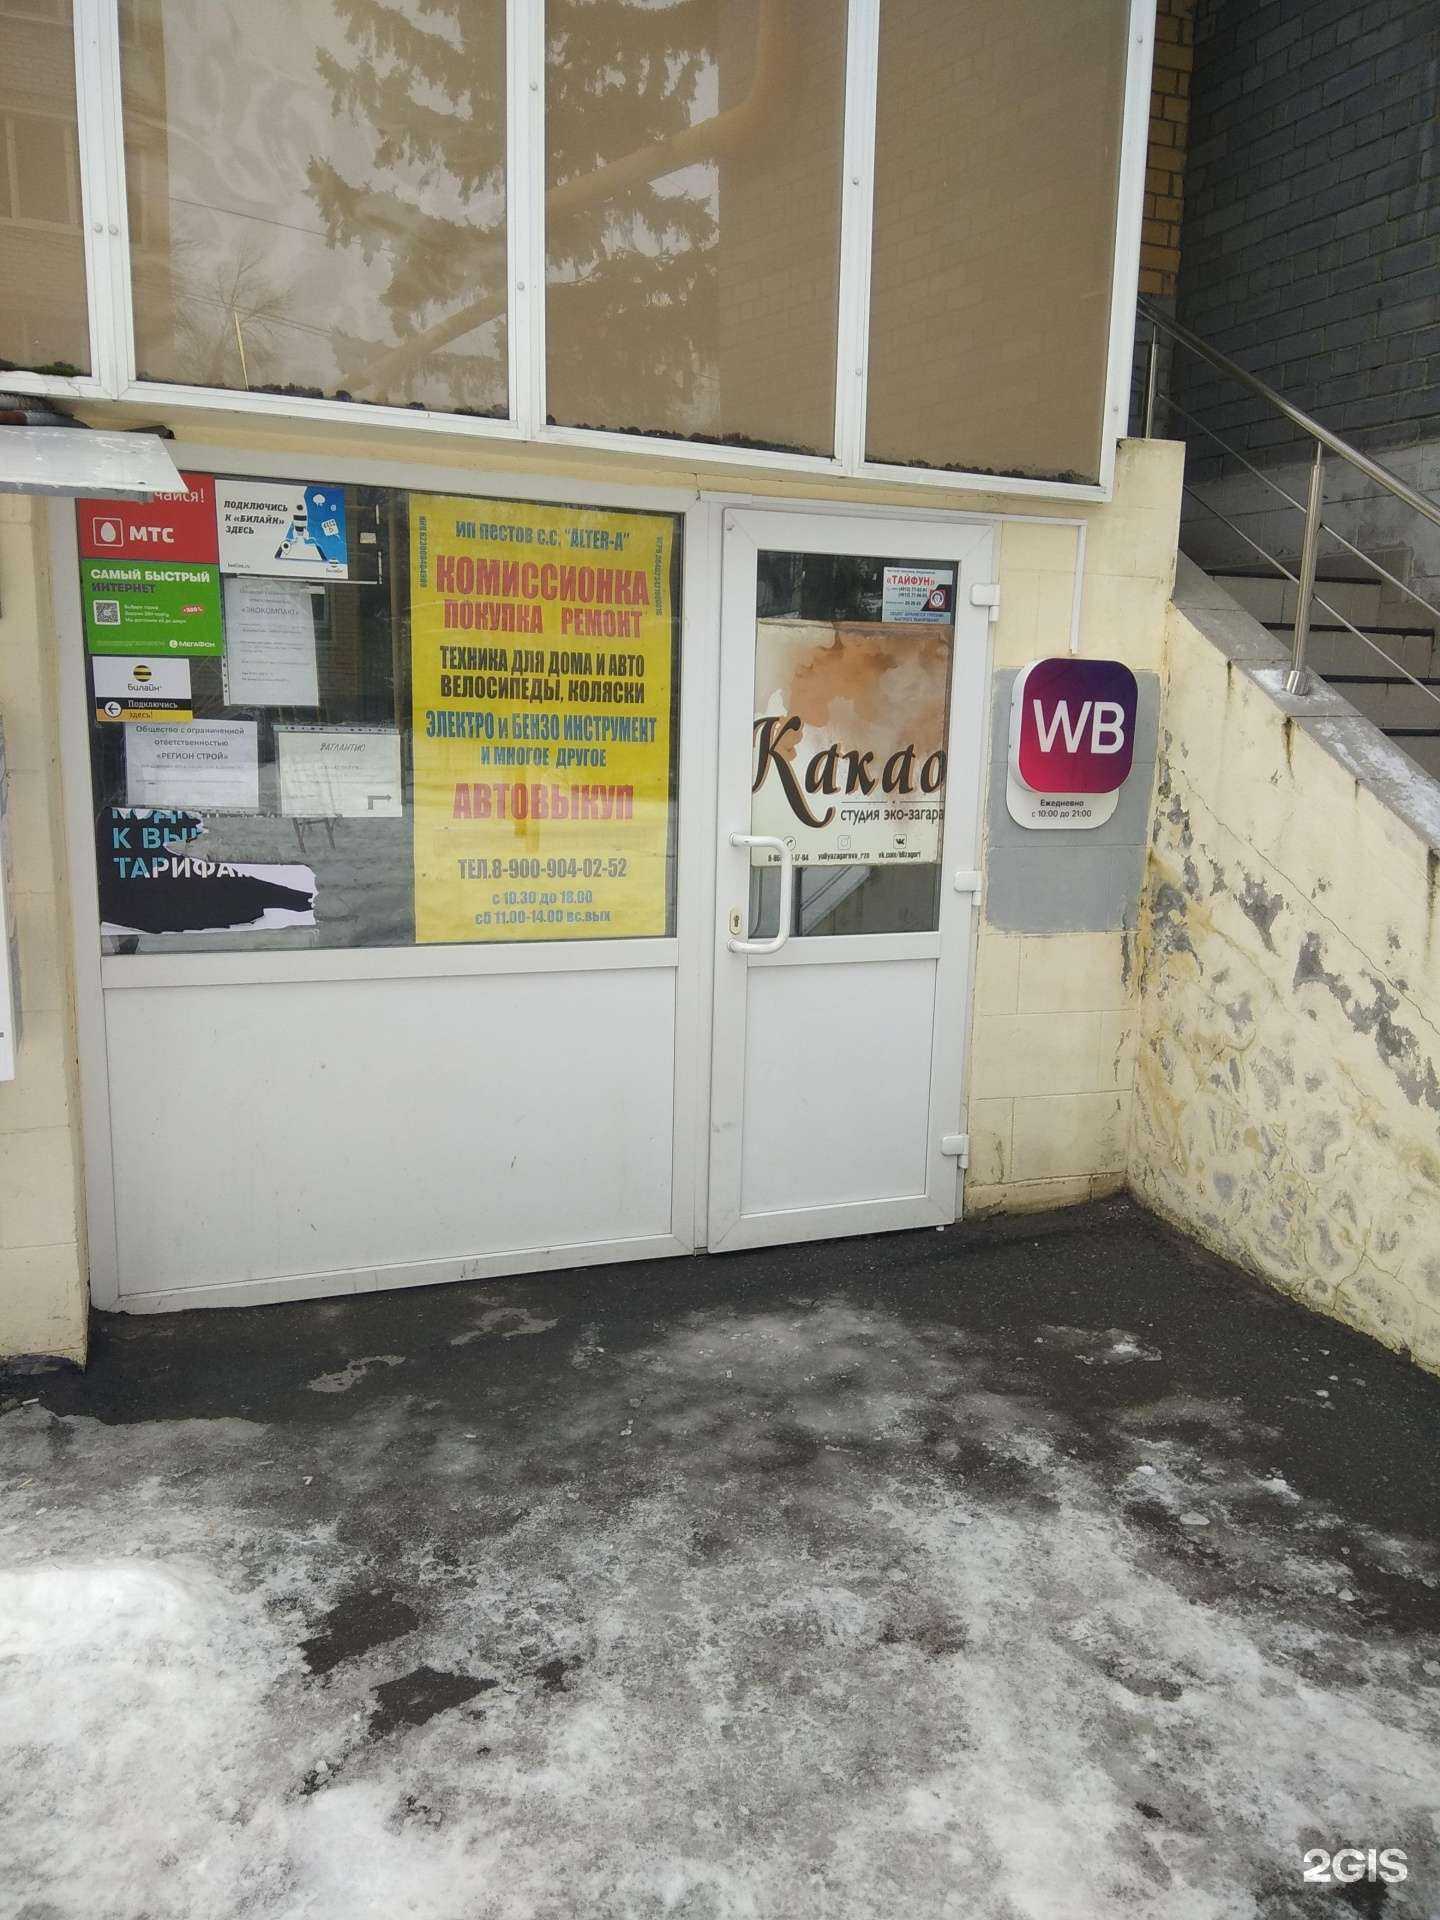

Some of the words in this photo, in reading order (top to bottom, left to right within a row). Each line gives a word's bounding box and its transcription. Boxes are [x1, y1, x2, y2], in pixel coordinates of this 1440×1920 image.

[224, 500, 288, 512] ПОДКЛЮЧИСЬ
[234, 515, 285, 525] «БИЛАЙН»
[129, 526, 175, 543] МТС
[225, 526, 255, 535] ЗДЕСЬ
[455, 520, 475, 539] ИП
[91, 569, 141, 580] САМЫЙ
[145, 571, 210, 583] БЫСТРЫЙ
[436, 555, 650, 605] КОМИССИОНКА
[886, 574, 935, 586] «ТАЙФУН»
[92, 582, 155, 593] ИНТЕРНЕТ
[444, 600, 544, 633] ПОКУПКА
[561, 607, 643, 638] РЕМОНТ
[440, 646, 508, 672] ТЕХНИКА
[511, 650, 544, 676] ДЛЯ
[549, 652, 593, 677] ДОМА
[596, 654, 605, 676] И
[608, 654, 645, 678] АВТО
[128, 683, 160, 692] Билайн
[440, 674, 564, 704] ВЕЛОСИПЕДЫ,
[568, 680, 645, 704] КОЛЯСКИ
[128, 699, 178, 710] Подключись
[136, 725, 178, 734] Общество
[187, 727, 245, 735] ограниченной
[426, 711, 494, 739] ЭЛЕКТРО
[512, 712, 560, 741] БЕНЗО
[564, 715, 657, 743] ИНСТРУМЕНТ
[1033, 699, 1125, 754] WB
[154, 739, 229, 747] ответственностью
[156, 752, 194, 761] «РЕГИОН
[196, 751, 228, 761] СТРОЙ»
[481, 746, 490, 765] И
[494, 747, 549, 766] МНОГОЕ
[556, 748, 607, 768] ДРУГОЕ
[753, 716, 948, 829] Какао
[453, 783, 634, 820] АВТОВЫКУП
[1040, 799, 1084, 808] Ежедневно
[840, 808, 880, 825] студия
[883, 807, 944, 825] эко-загара
[112, 827, 132, 849] К
[142, 827, 202, 849] ВЫ
[457, 858, 627, 880] ТЕЛ.8-900-904-02-52
[504, 891, 537, 905] 10.30
[540, 891, 557, 905] до
[561, 889, 593, 904] 18.00
[496, 909, 564, 924] 11.00-14.00
